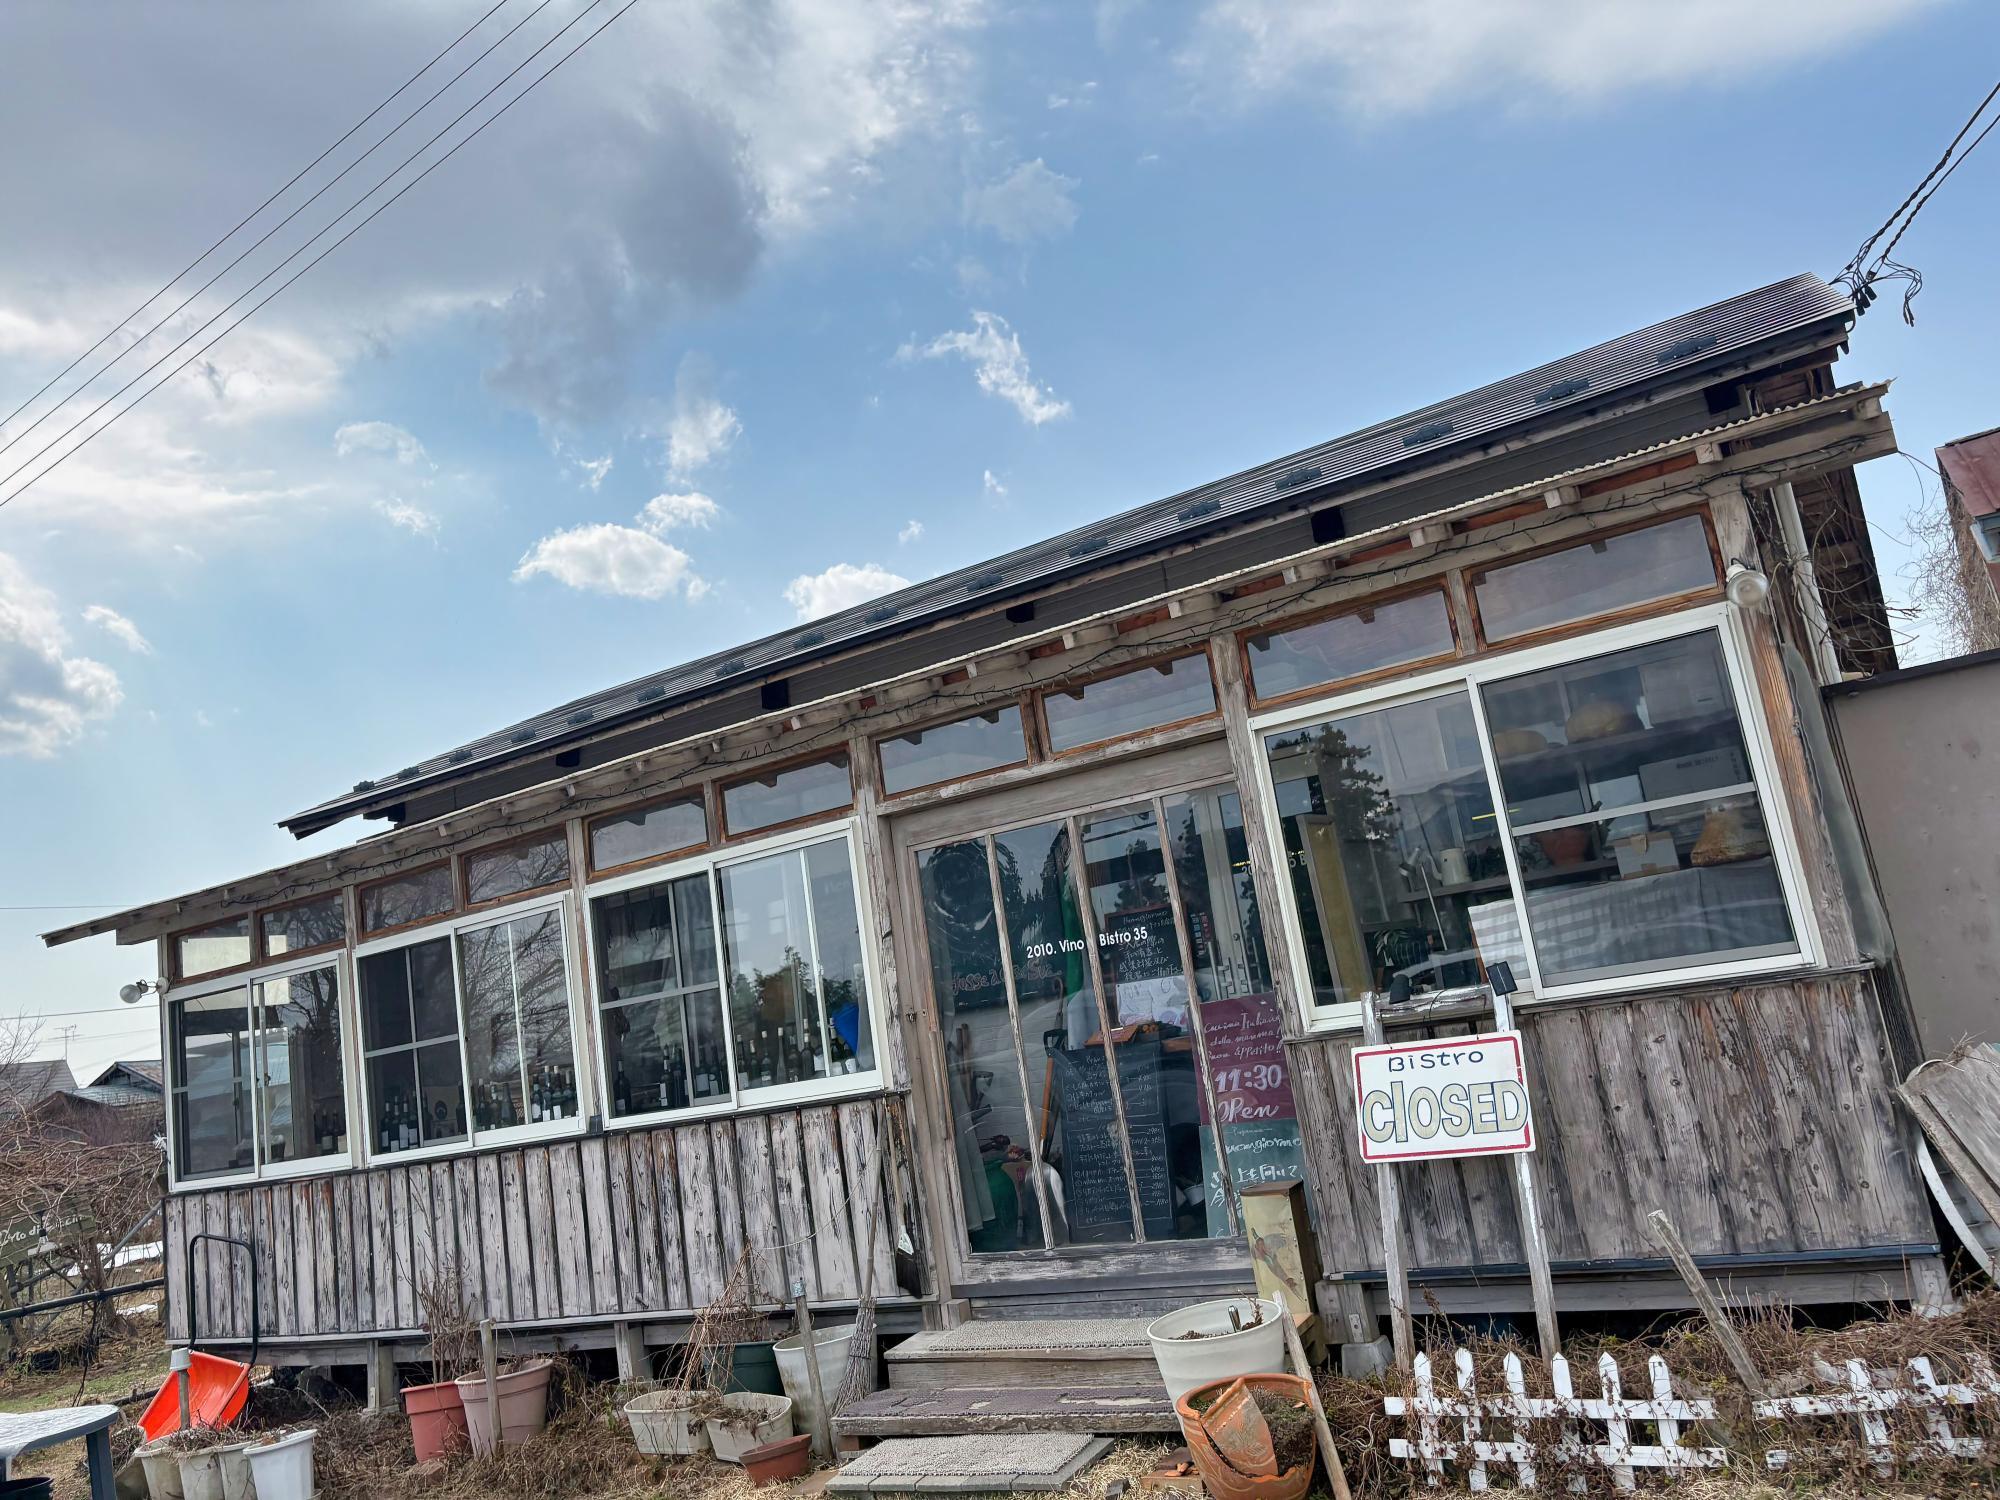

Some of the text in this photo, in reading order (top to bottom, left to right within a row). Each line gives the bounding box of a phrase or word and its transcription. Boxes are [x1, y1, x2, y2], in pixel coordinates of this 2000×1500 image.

[1026, 943, 1057, 959] 2010.
[1059, 939, 1085, 953] Vino
[1099, 930, 1132, 947] Bistro
[1133, 926, 1148, 940] 35
[1214, 1064, 1282, 1093] 11:30
[1213, 1137, 1302, 1155] uongiorno
